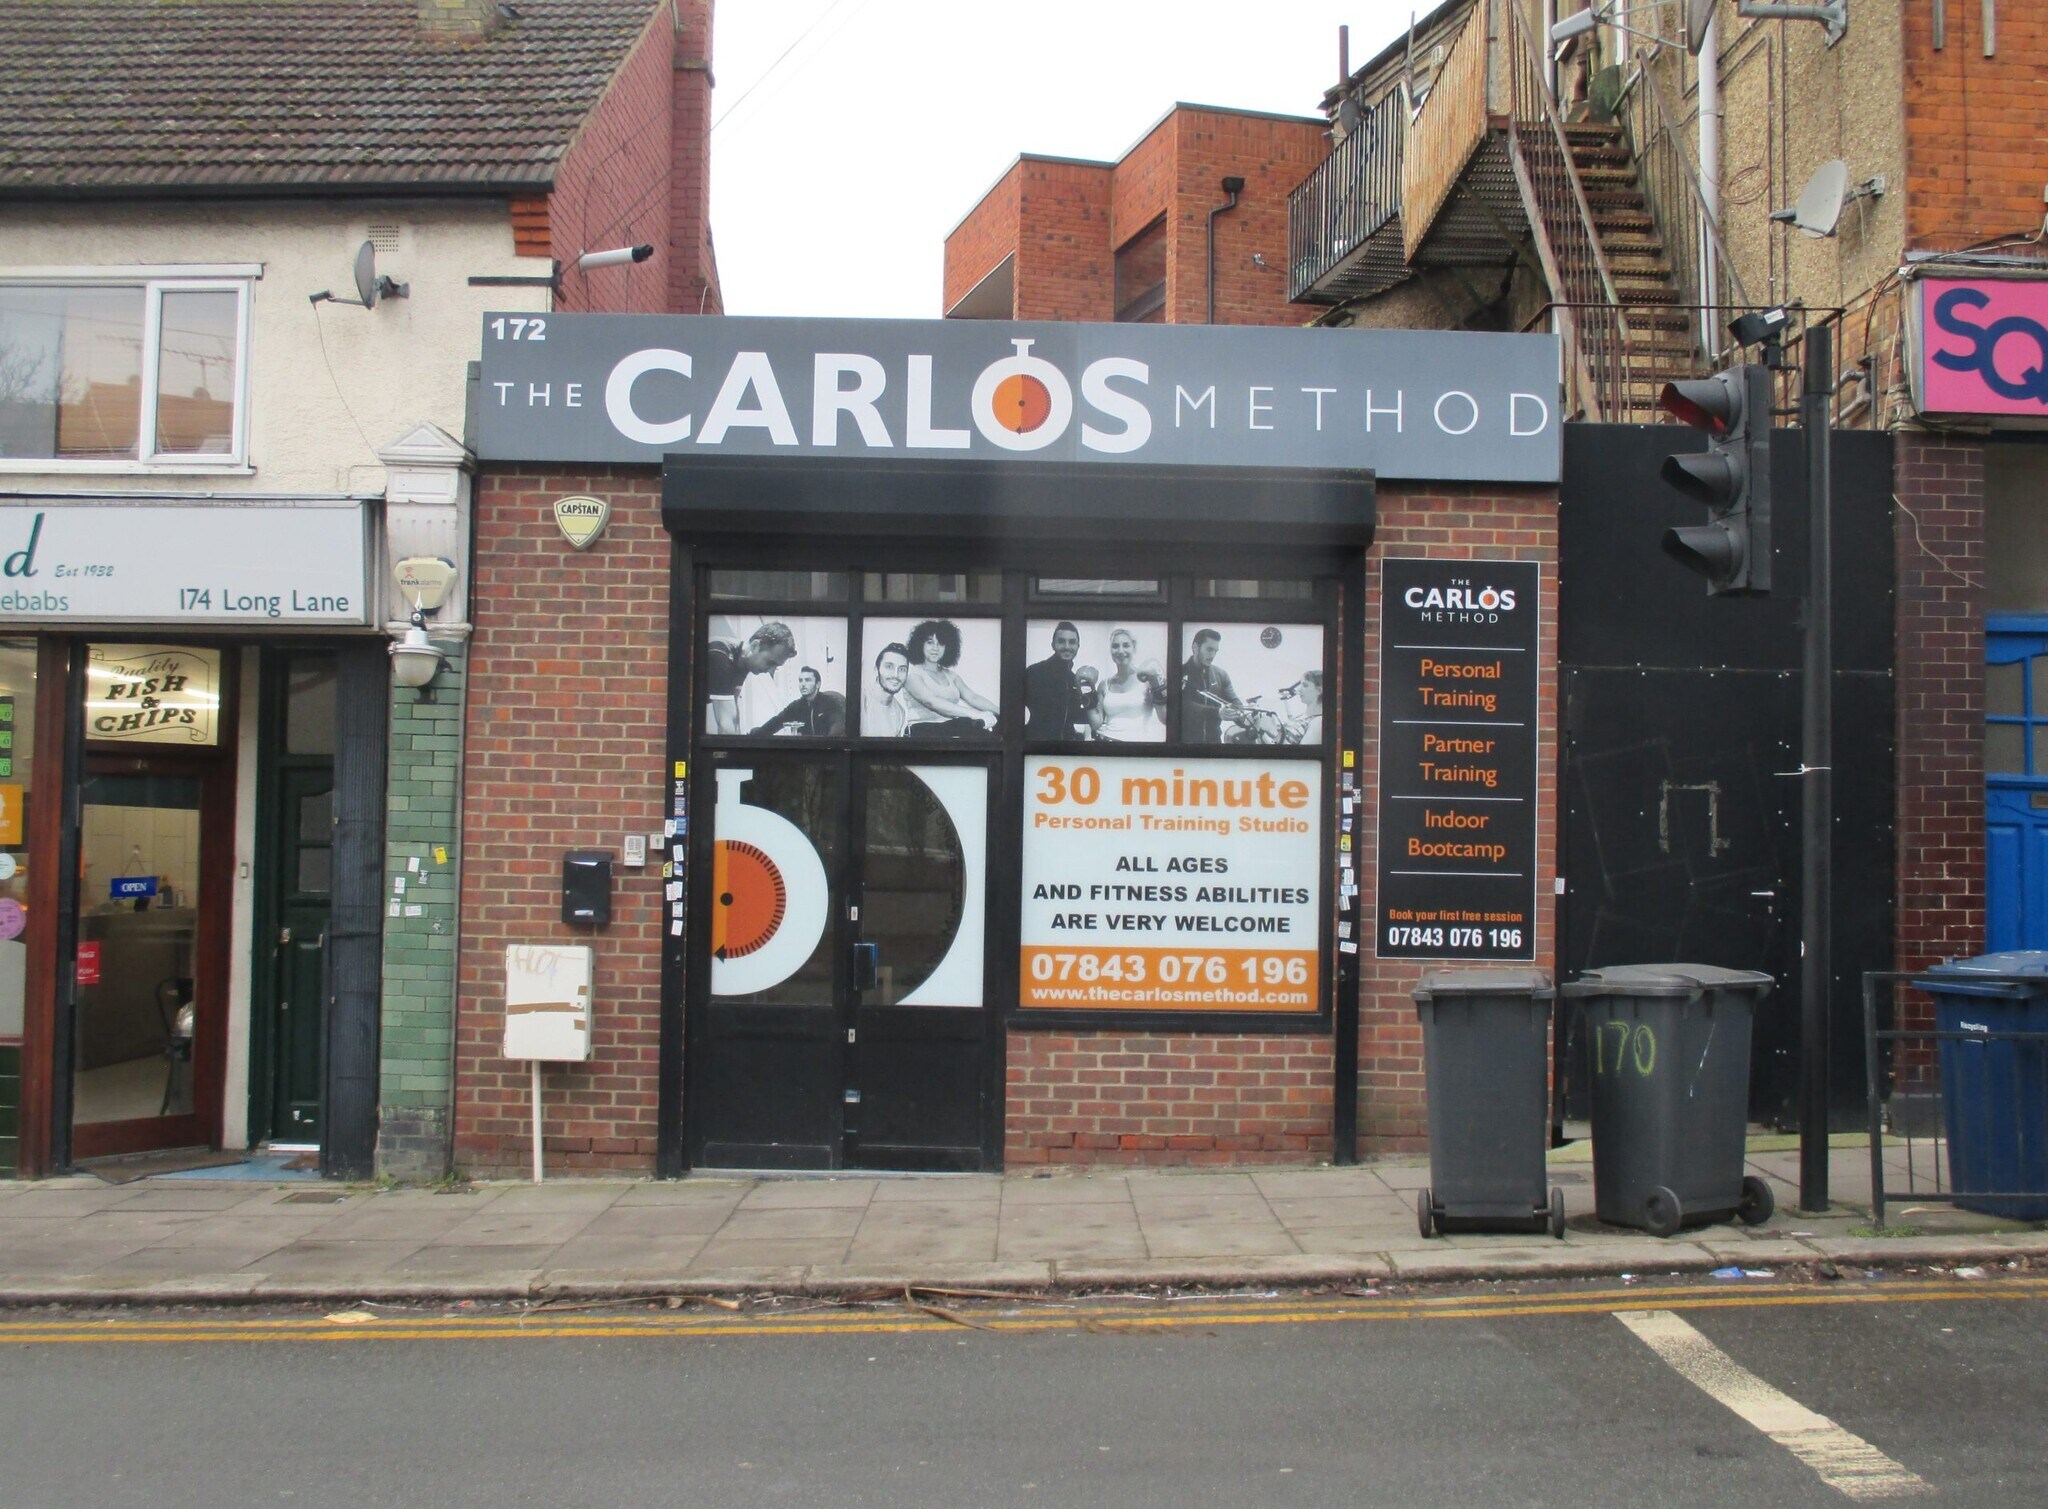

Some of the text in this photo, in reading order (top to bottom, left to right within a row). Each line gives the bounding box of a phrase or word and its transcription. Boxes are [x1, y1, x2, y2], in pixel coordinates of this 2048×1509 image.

[491, 319, 546, 341] 172
[1931, 288, 2048, 405] SQ
[494, 339, 1549, 454] THE CARLOS METHOD
[561, 503, 599, 515] CAPSTAN
[55, 564, 114, 578] Est 1932
[180, 588, 349, 617] 174 Long Lane
[1404, 586, 1516, 611] CARLOS
[1421, 612, 1499, 624] METHOD
[1421, 658, 1501, 679] Personal
[105, 675, 188, 700] FISH
[141, 696, 160, 709] &
[1419, 687, 1497, 712] Training
[95, 708, 196, 732] CHIPS
[1424, 734, 1496, 753] Partner
[1419, 762, 1498, 787] Training
[1036, 766, 1101, 805] 30
[1121, 769, 1310, 809] minute
[1034, 812, 1310, 836] Personal Training Studio
[1425, 810, 1489, 829] Indoor
[1408, 838, 1507, 863] Bootcamp
[1116, 856, 1228, 874] ALL AGES
[121, 882, 147, 892] OPEN
[1033, 884, 1310, 905] AND FITNESS ABILITIES
[1051, 914, 1291, 933] ARE VERY WELCOME
[1389, 909, 1522, 923] Book your first free session
[1388, 927, 1522, 948] 07843 076 196
[1031, 954, 1307, 985] 07843 076 196
[1031, 986, 1308, 1003] www.thecarlosmethod.com
[1597, 1021, 1656, 1076] 170
